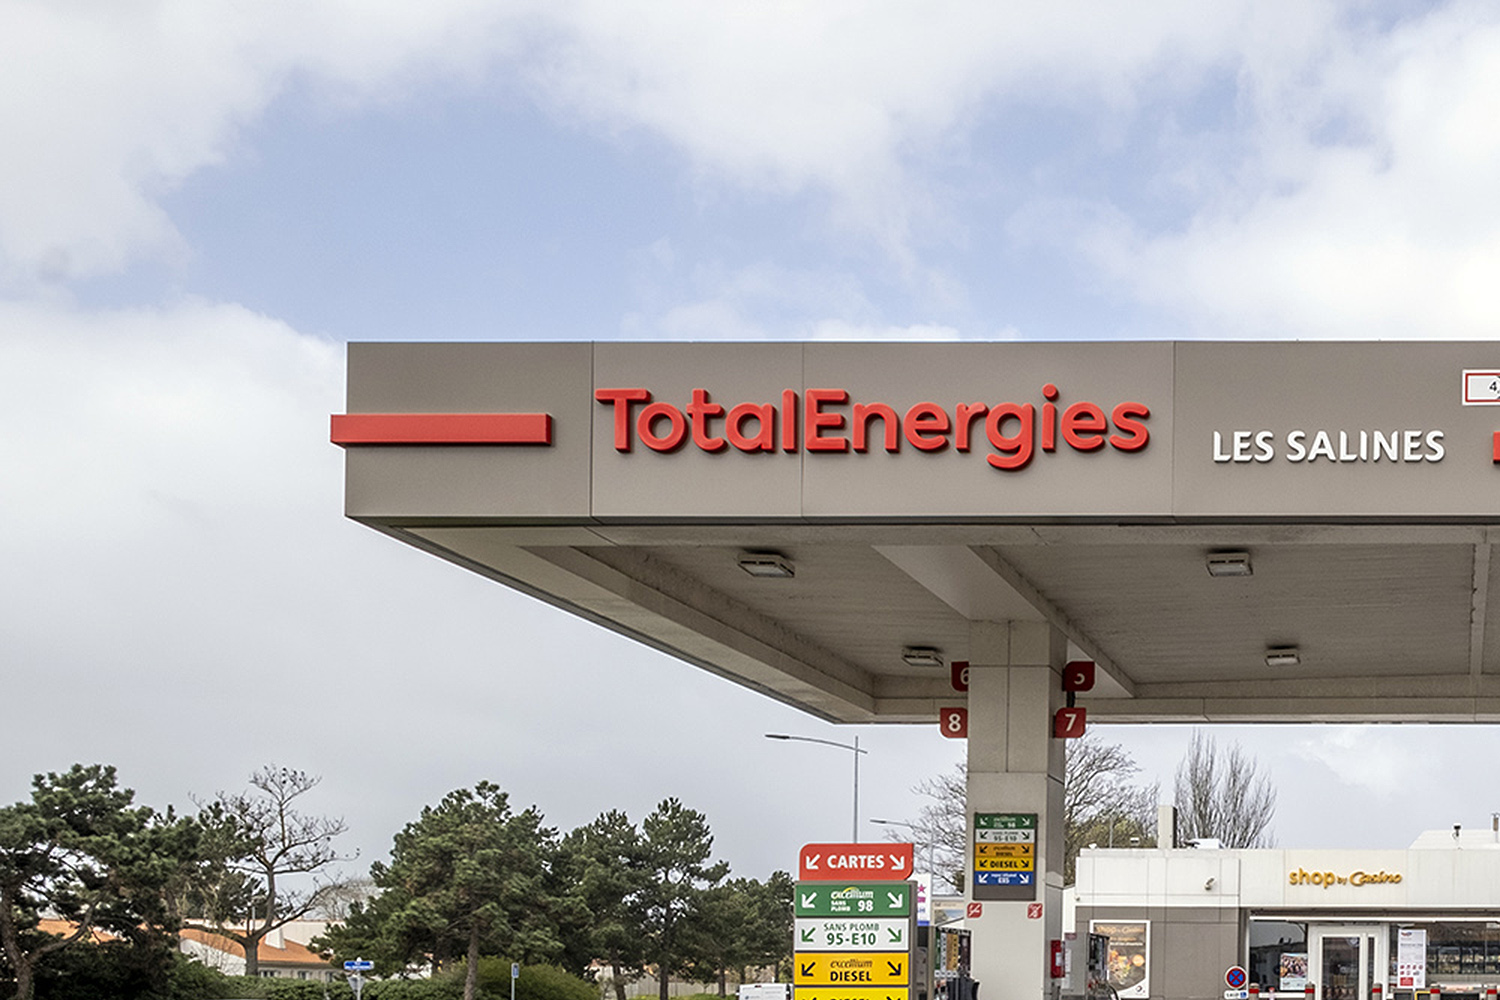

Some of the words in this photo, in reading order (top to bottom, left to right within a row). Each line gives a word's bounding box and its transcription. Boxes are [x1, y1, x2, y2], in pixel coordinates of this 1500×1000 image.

[595, 383, 1151, 472] TotalEnergies
[1213, 430, 1276, 463] LES
[1286, 430, 1446, 463] SALINES
[948, 713, 962, 732] 8
[1064, 713, 1078, 732] 7
[827, 854, 885, 869] CARTES
[989, 861, 1019, 869] DIESEL
[1289, 867, 1336, 890] shop
[1349, 871, 1403, 887] Casino
[858, 899, 874, 912] 98
[823, 923, 847, 932] SANS
[849, 923, 880, 932] PLOMB
[826, 932, 877, 945] 95-E10
[830, 958, 873, 968] excellium
[830, 971, 872, 982] DIESEL
